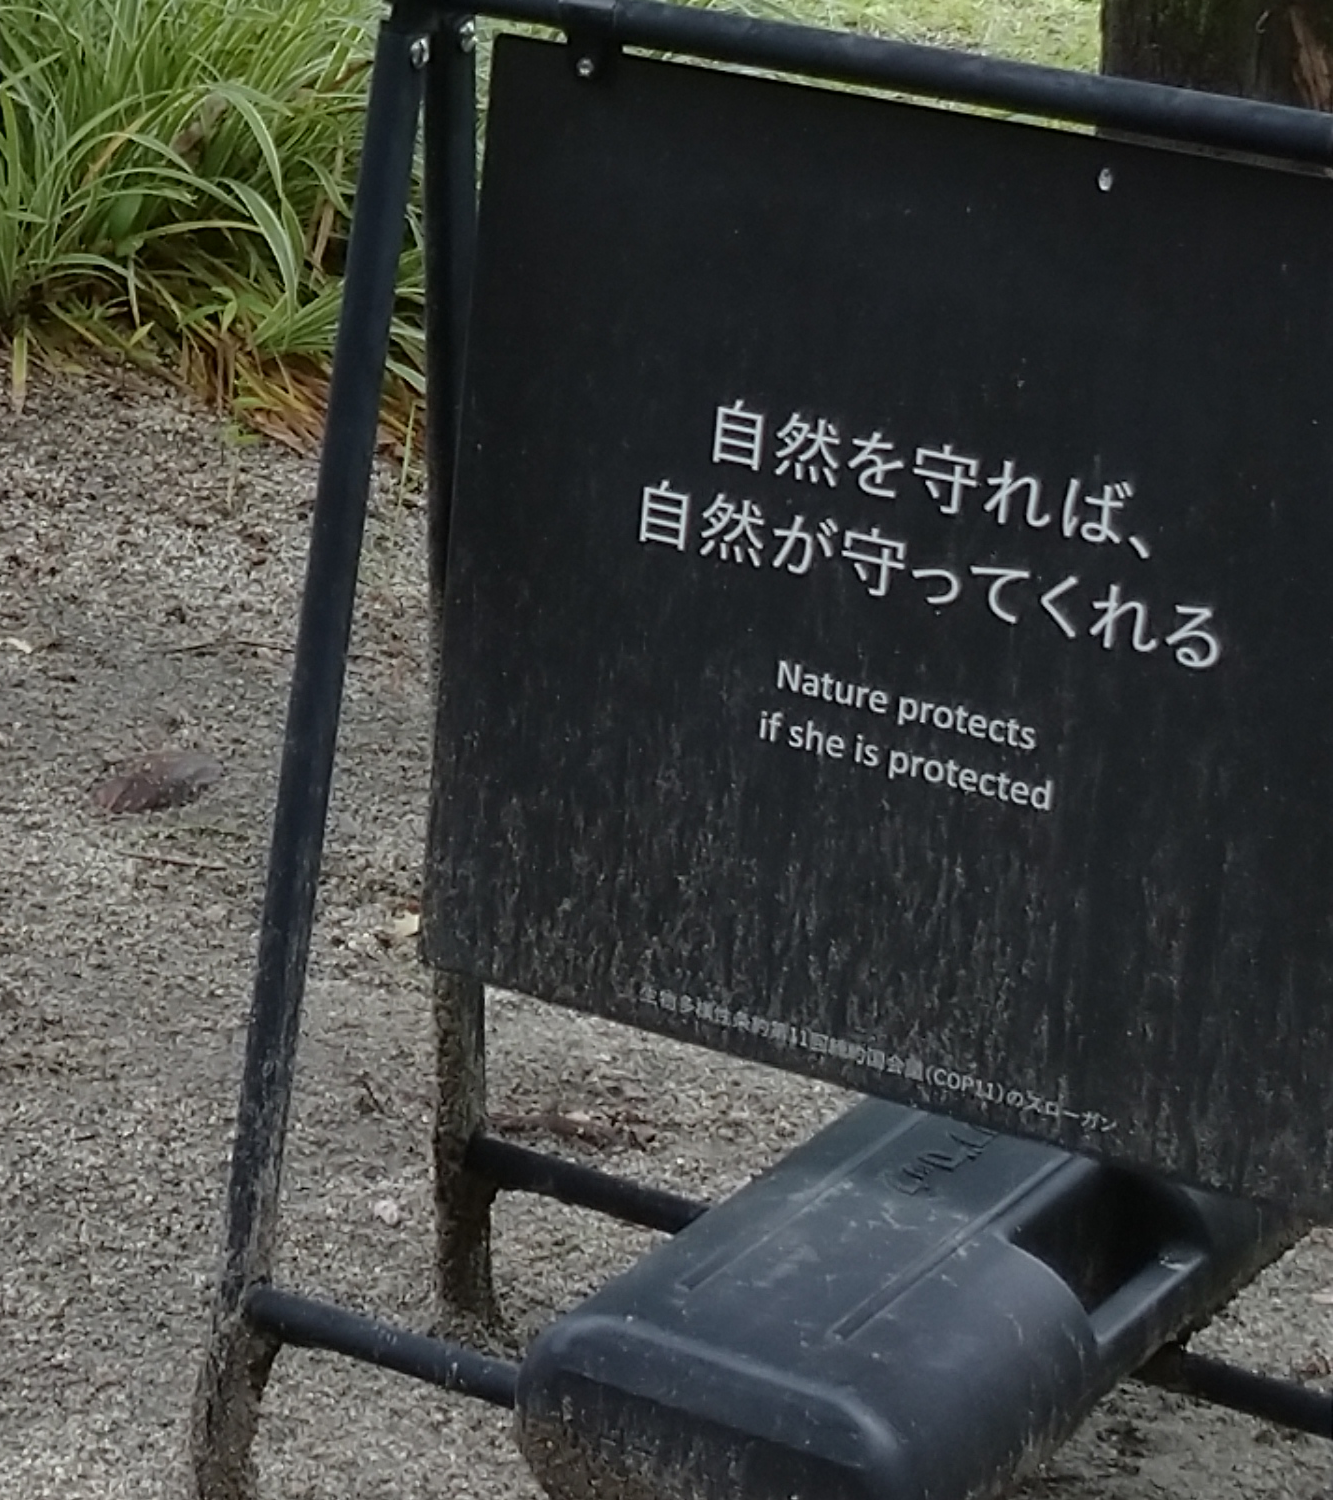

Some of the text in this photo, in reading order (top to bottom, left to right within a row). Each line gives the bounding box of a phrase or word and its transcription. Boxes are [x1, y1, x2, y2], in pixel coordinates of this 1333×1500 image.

[710, 399, 1151, 560] 自然を守れば、
[637, 479, 1221, 669] 自然が守ってくれる
[757, 711, 1054, 812] if she is protected
[776, 660, 1037, 750] Nature protects
